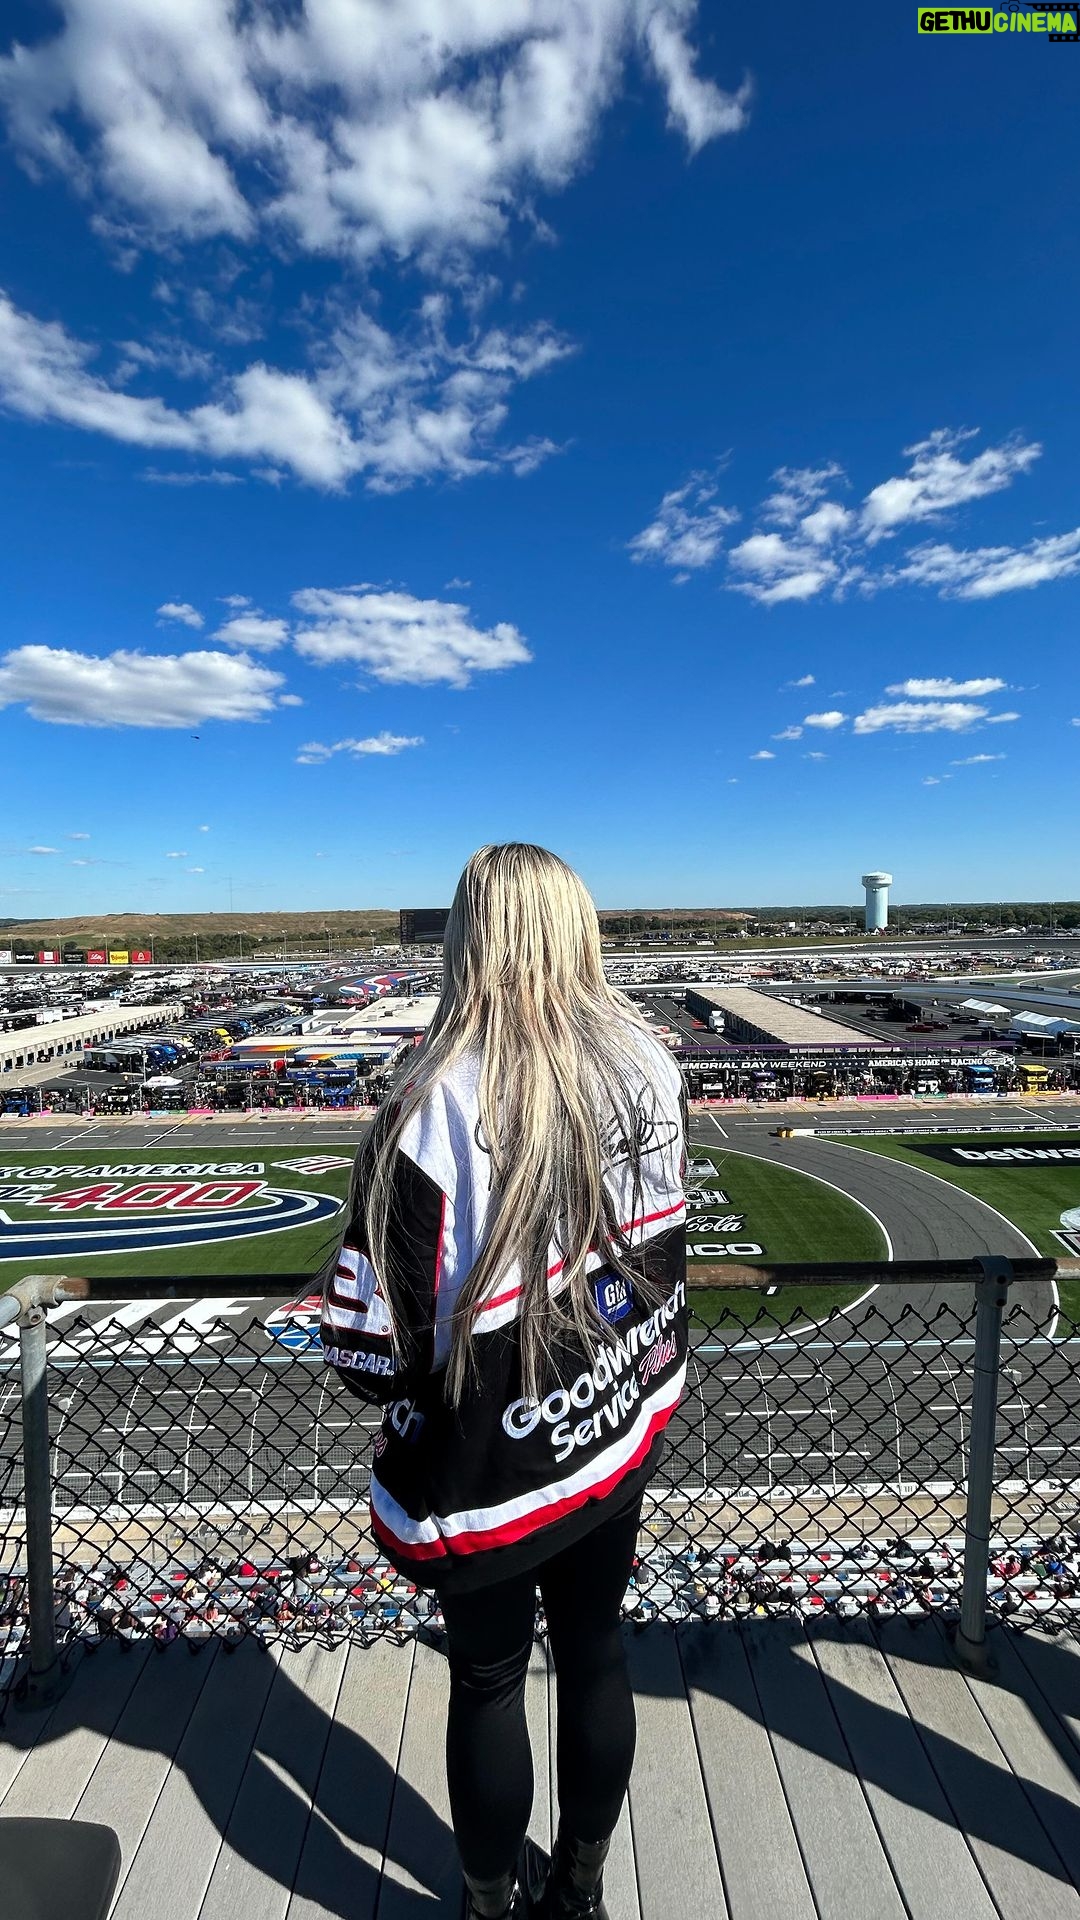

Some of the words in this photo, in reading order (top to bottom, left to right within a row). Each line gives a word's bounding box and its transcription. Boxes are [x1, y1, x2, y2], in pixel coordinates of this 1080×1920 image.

[679, 1062, 740, 1070] EMORIAL
[770, 1060, 827, 1069] WEEKEND
[868, 1059, 914, 1067] AMERICA'S
[915, 1058, 940, 1067] HOME
[951, 1057, 983, 1066] RACING
[951, 1148, 1080, 1160] betwa
[76, 1163, 265, 1177] AMERICA
[27, 1181, 267, 1210] 400
[323, 1345, 391, 1376] NASCAR
[551, 1371, 640, 1463] Service
